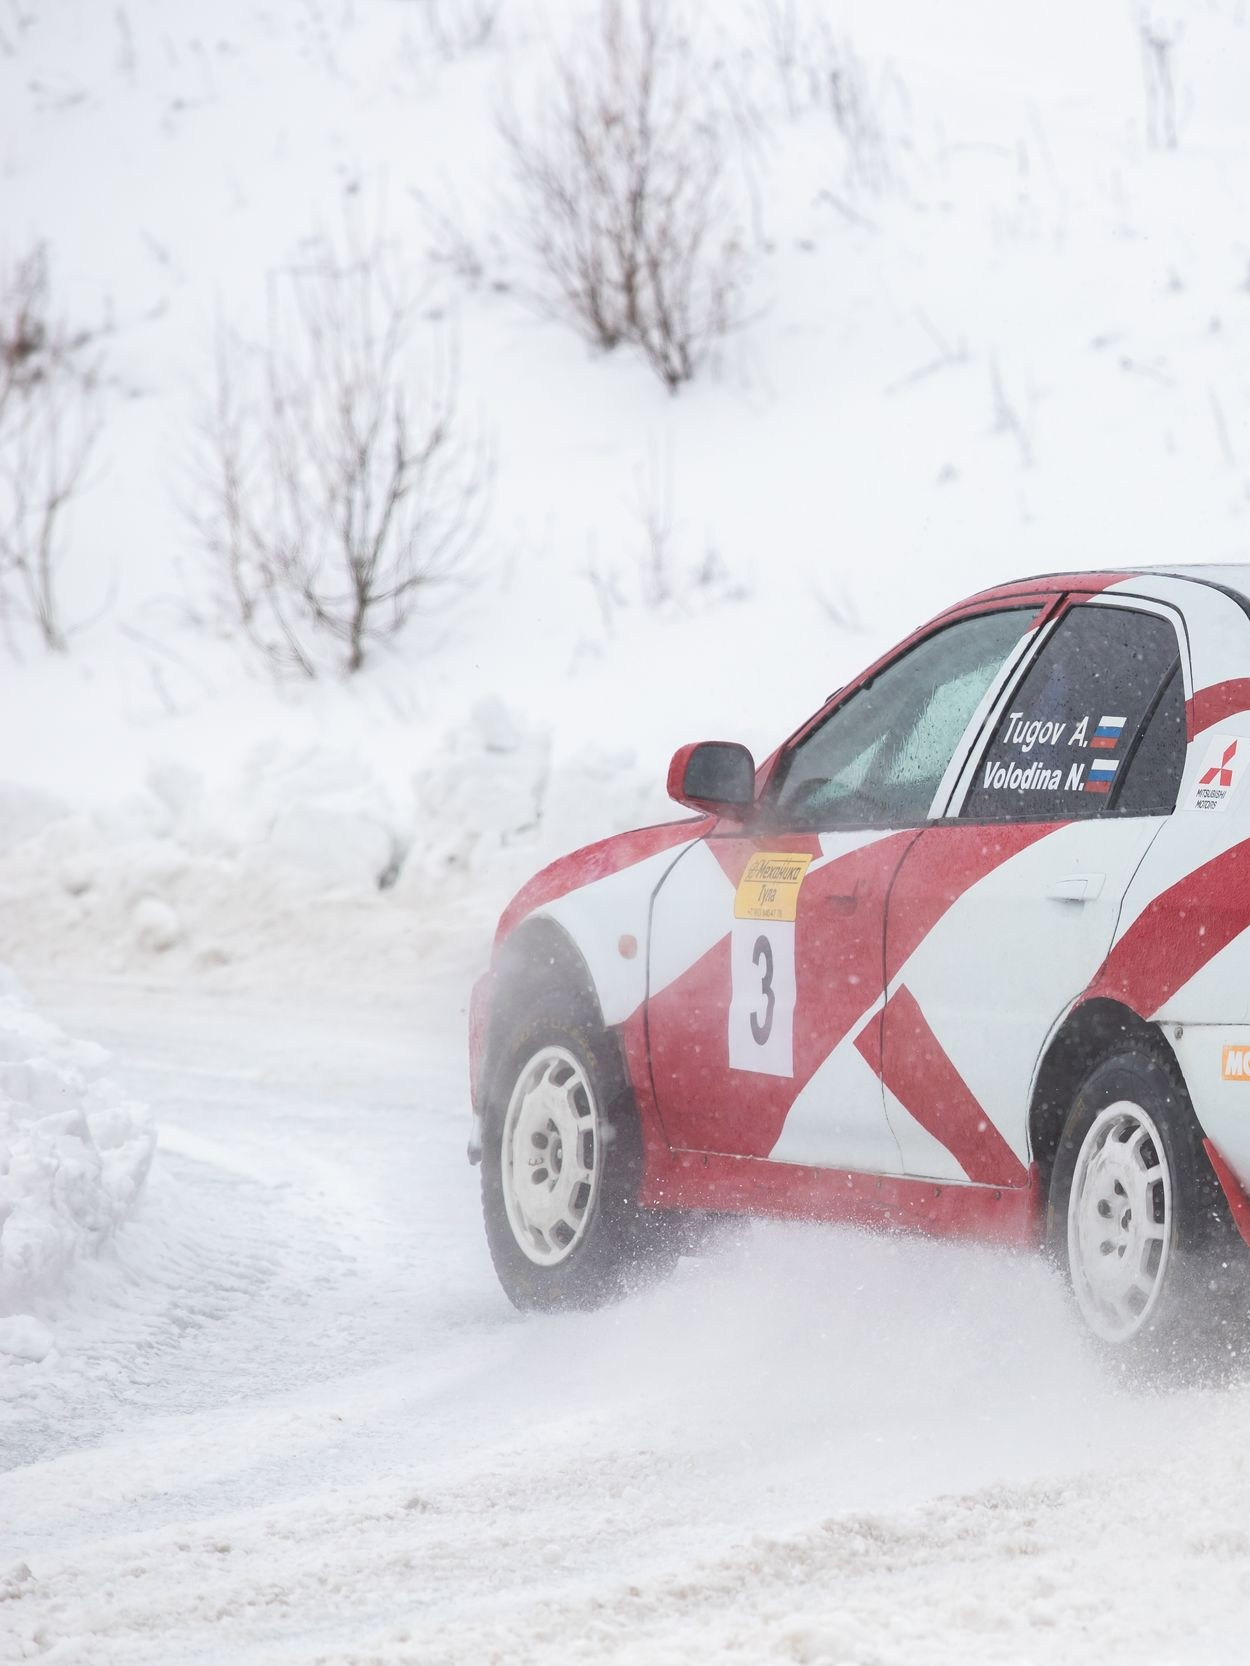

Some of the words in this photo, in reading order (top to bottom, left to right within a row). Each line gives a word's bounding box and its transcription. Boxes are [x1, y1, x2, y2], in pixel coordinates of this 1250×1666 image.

[1003, 712, 1066, 753] Tugov
[1068, 716, 1089, 747] A.
[983, 761, 1062, 790] Volodina
[1064, 763, 1086, 791] N.
[1195, 800, 1218, 809] MOTORS
[1196, 788, 1227, 799] MITSUBISHI
[750, 935, 775, 1046] 3
